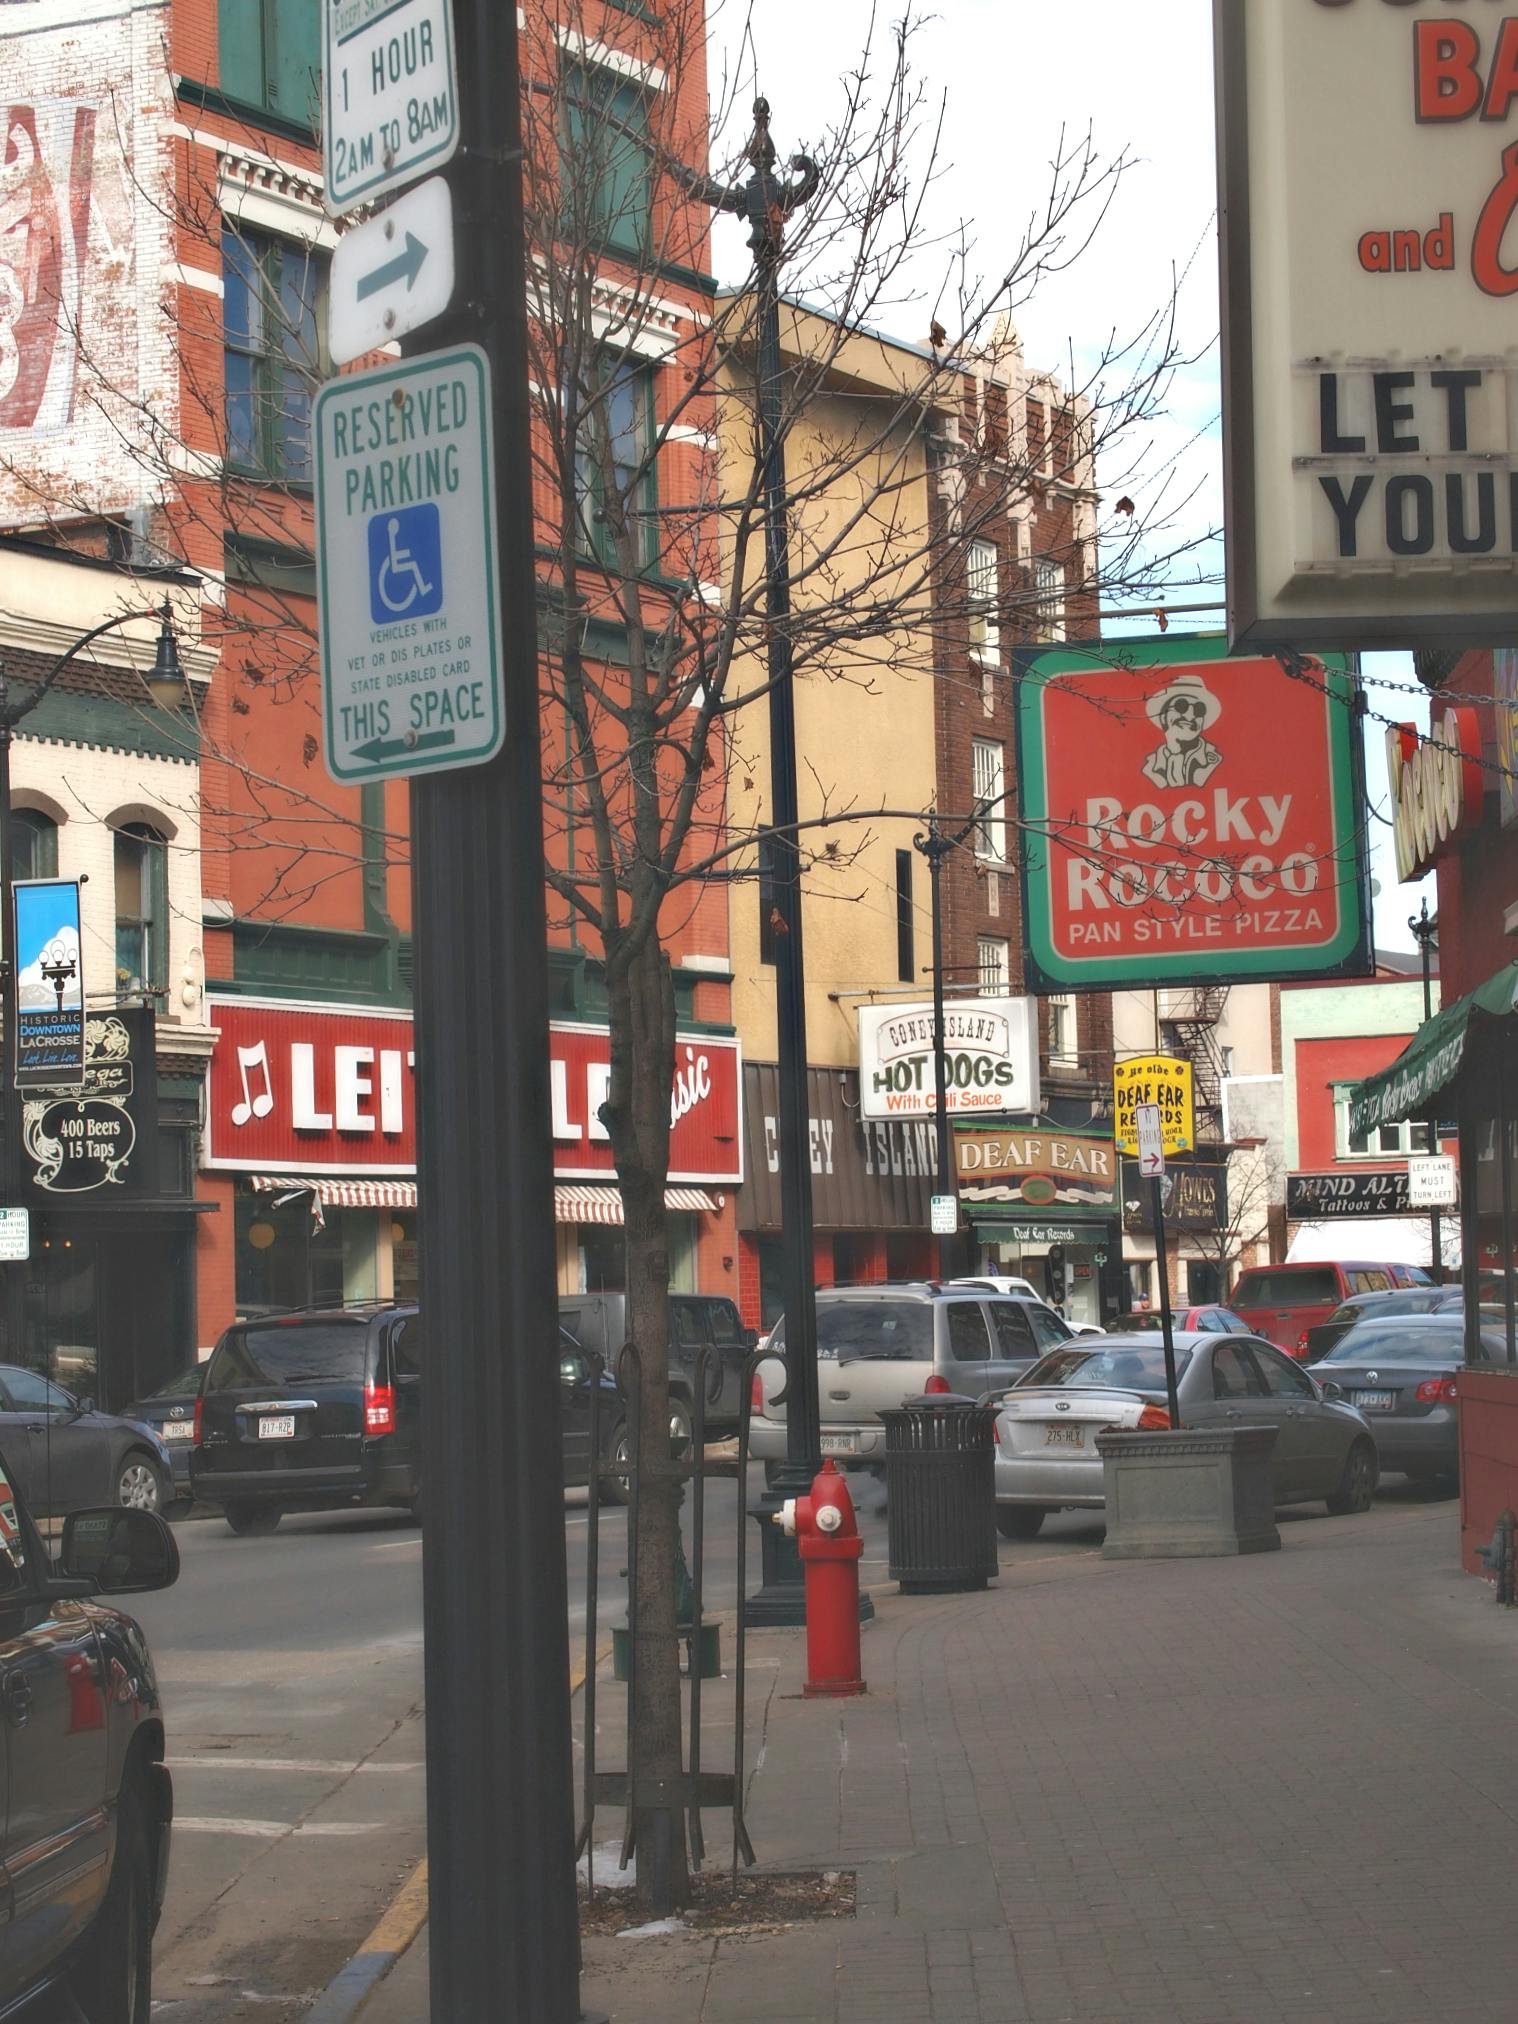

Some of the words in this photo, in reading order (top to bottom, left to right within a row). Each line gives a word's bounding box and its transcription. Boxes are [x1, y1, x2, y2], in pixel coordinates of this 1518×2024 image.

[342, 68, 348, 112] 1
[372, 19, 433, 95] HOUR
[335, 132, 373, 184] 2AM
[379, 119, 400, 156] TO
[407, 92, 448, 144] 8AM
[1358, 212, 1455, 273] and
[333, 380, 467, 459] RESERVED
[1320, 370, 1481, 453] LET
[346, 444, 459, 516] PARKING
[1318, 472, 1518, 556] YOU
[370, 623, 417, 644] VEHICLES
[423, 617, 447, 633] WITH
[348, 656, 365, 671] VET
[372, 652, 385, 667] OR
[391, 649, 408, 663] DIS
[413, 640, 451, 658] PLATES
[457, 635, 472, 650] OR
[351, 677, 381, 694] STATE
[386, 667, 436, 688] DISABLED
[442, 660, 470, 677] CARD
[340, 699, 390, 742] THIS
[410, 681, 485, 729] SPACE
[1086, 788, 1293, 849] Rocky
[1067, 852, 1320, 911] Rococo
[1069, 922, 1121, 945] PAN
[1133, 914, 1222, 942] STYLE
[1235, 908, 1323, 935] PIZZA
[20, 1014, 81, 1025] HISTORIC
[20, 1024, 81, 1036] DOWNTOWN
[889, 1016, 937, 1047] CONEY
[85, 1067, 122, 1080] ega
[873, 1055, 928, 1093] HOT
[944, 1052, 1014, 1089] DOGS
[886, 1094, 921, 1111] With
[925, 1092, 957, 1109] Cili
[960, 1091, 1002, 1108] Sauce
[1117, 1083, 1151, 1108] DEAF
[1157, 1083, 1184, 1107] EAR
[60, 1119, 84, 1138] 400
[87, 1118, 121, 1136] Beers
[1119, 1110, 1183, 1127] REDS
[68, 1141, 83, 1159] 15
[86, 1139, 115, 1163] Taps
[764, 1116, 833, 1174] CEY
[863, 1121, 938, 1176] ISLAND
[960, 1140, 1043, 1170] DEAF
[1050, 1142, 1110, 1176] EAR
[1413, 1164, 1431, 1172] LEFT
[1433, 1163, 1451, 1171] LANE
[1420, 1178, 1445, 1186] MUST
[1319, 1198, 1370, 1212] Tattoos
[1376, 1200, 1387, 1209] &
[1013, 1228, 1030, 1239] Deaf
[1032, 1228, 1045, 1239] Ear
[1047, 1228, 1075, 1240] Records
